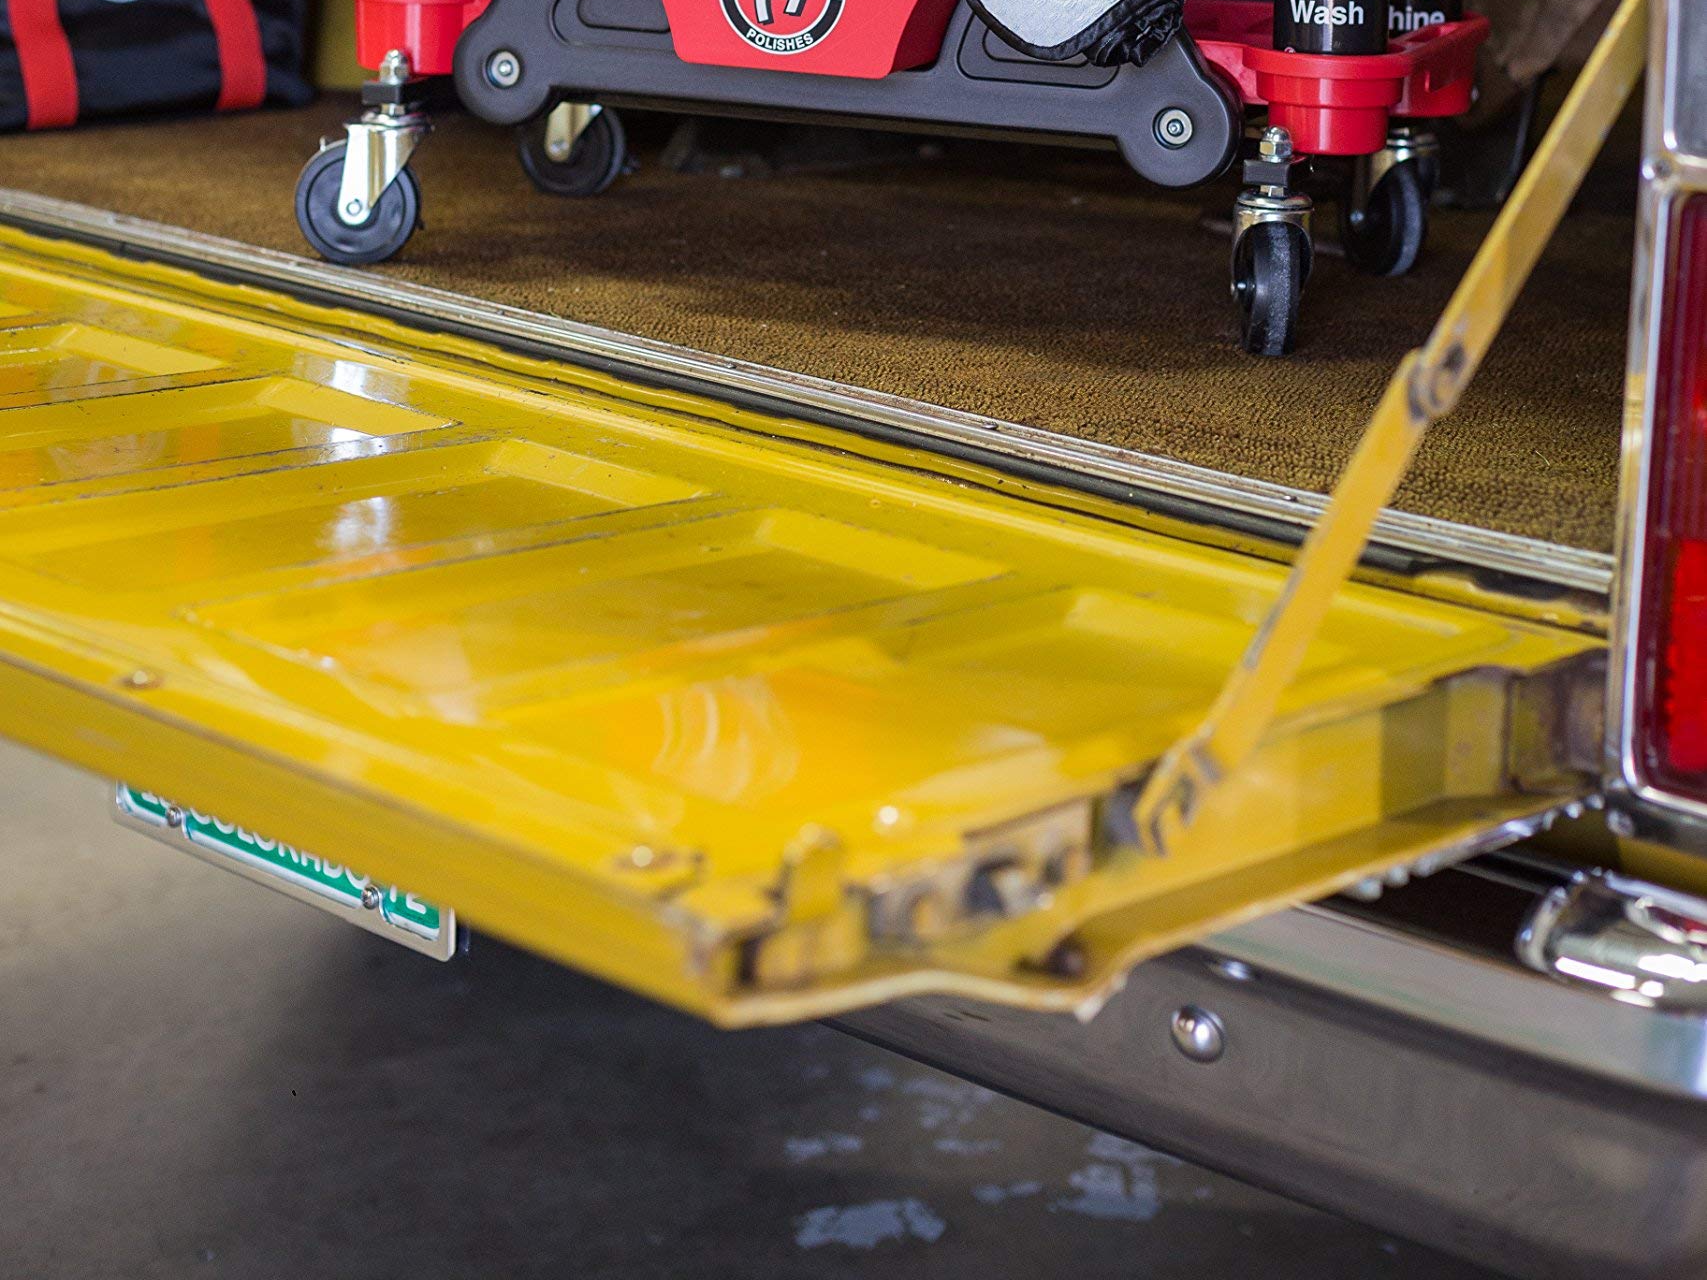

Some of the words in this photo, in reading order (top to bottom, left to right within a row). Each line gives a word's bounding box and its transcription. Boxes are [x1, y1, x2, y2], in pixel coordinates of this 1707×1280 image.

[1290, 0, 1365, 25] Wash
[1388, 5, 1446, 31] hine
[746, 28, 814, 51] POLISHES
